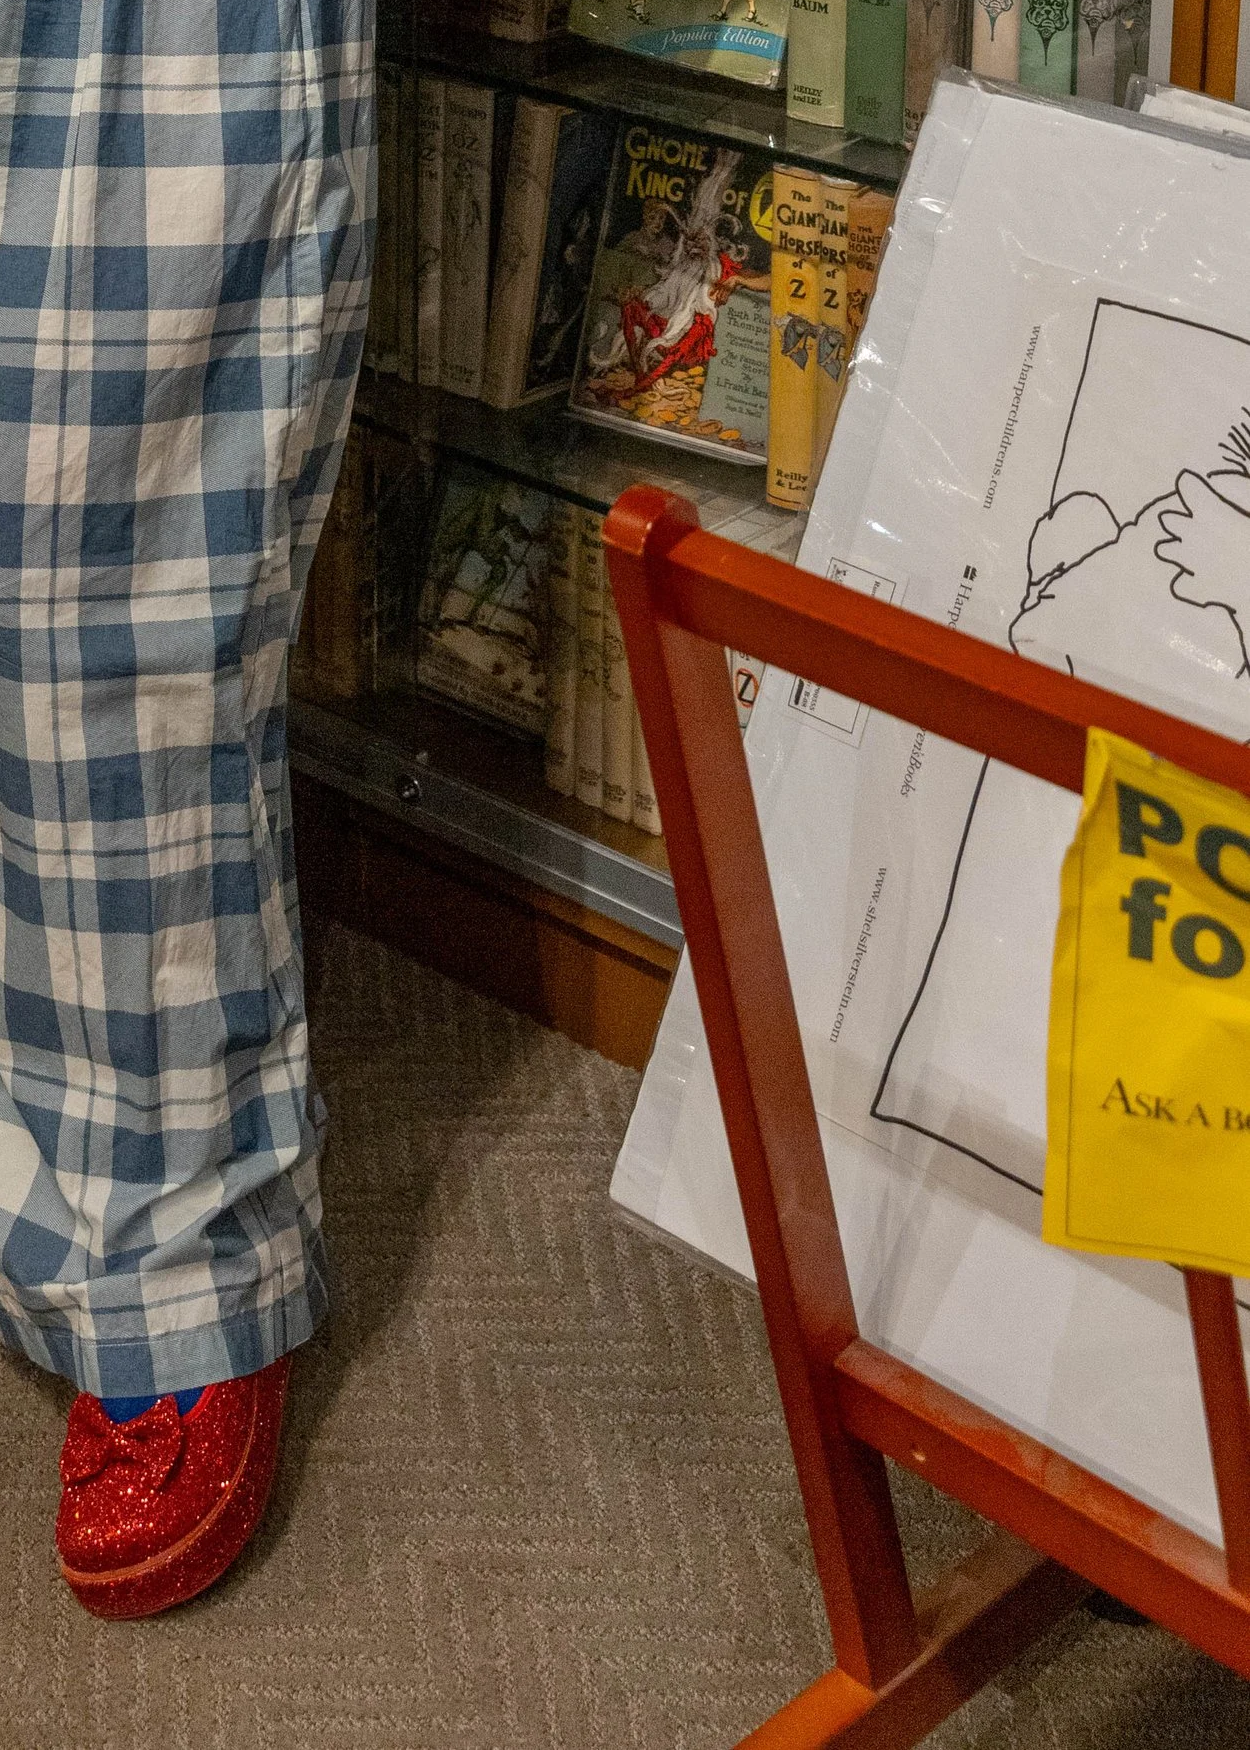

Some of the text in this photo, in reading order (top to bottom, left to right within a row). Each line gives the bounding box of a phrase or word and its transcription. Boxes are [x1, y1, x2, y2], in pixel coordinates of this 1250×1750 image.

[661, 26, 770, 51] Popular Edition
[792, 83, 824, 97] REILLY
[807, 96, 823, 107] LEE
[624, 125, 708, 171] GNOME
[625, 160, 686, 203] KING
[721, 188, 749, 216] OF
[791, 189, 812, 204] The
[825, 199, 845, 213] The
[776, 202, 823, 229] GIANT
[792, 258, 803, 270] of
[826, 268, 837, 280] of
[982, 324, 1041, 510] www.harperchildrens.com
[775, 467, 809, 483] Reilly
[1120, 876, 1245, 980] fo
[829, 866, 887, 1044] www.shelsilverstein.com
[1186, 1100, 1212, 1129] A
